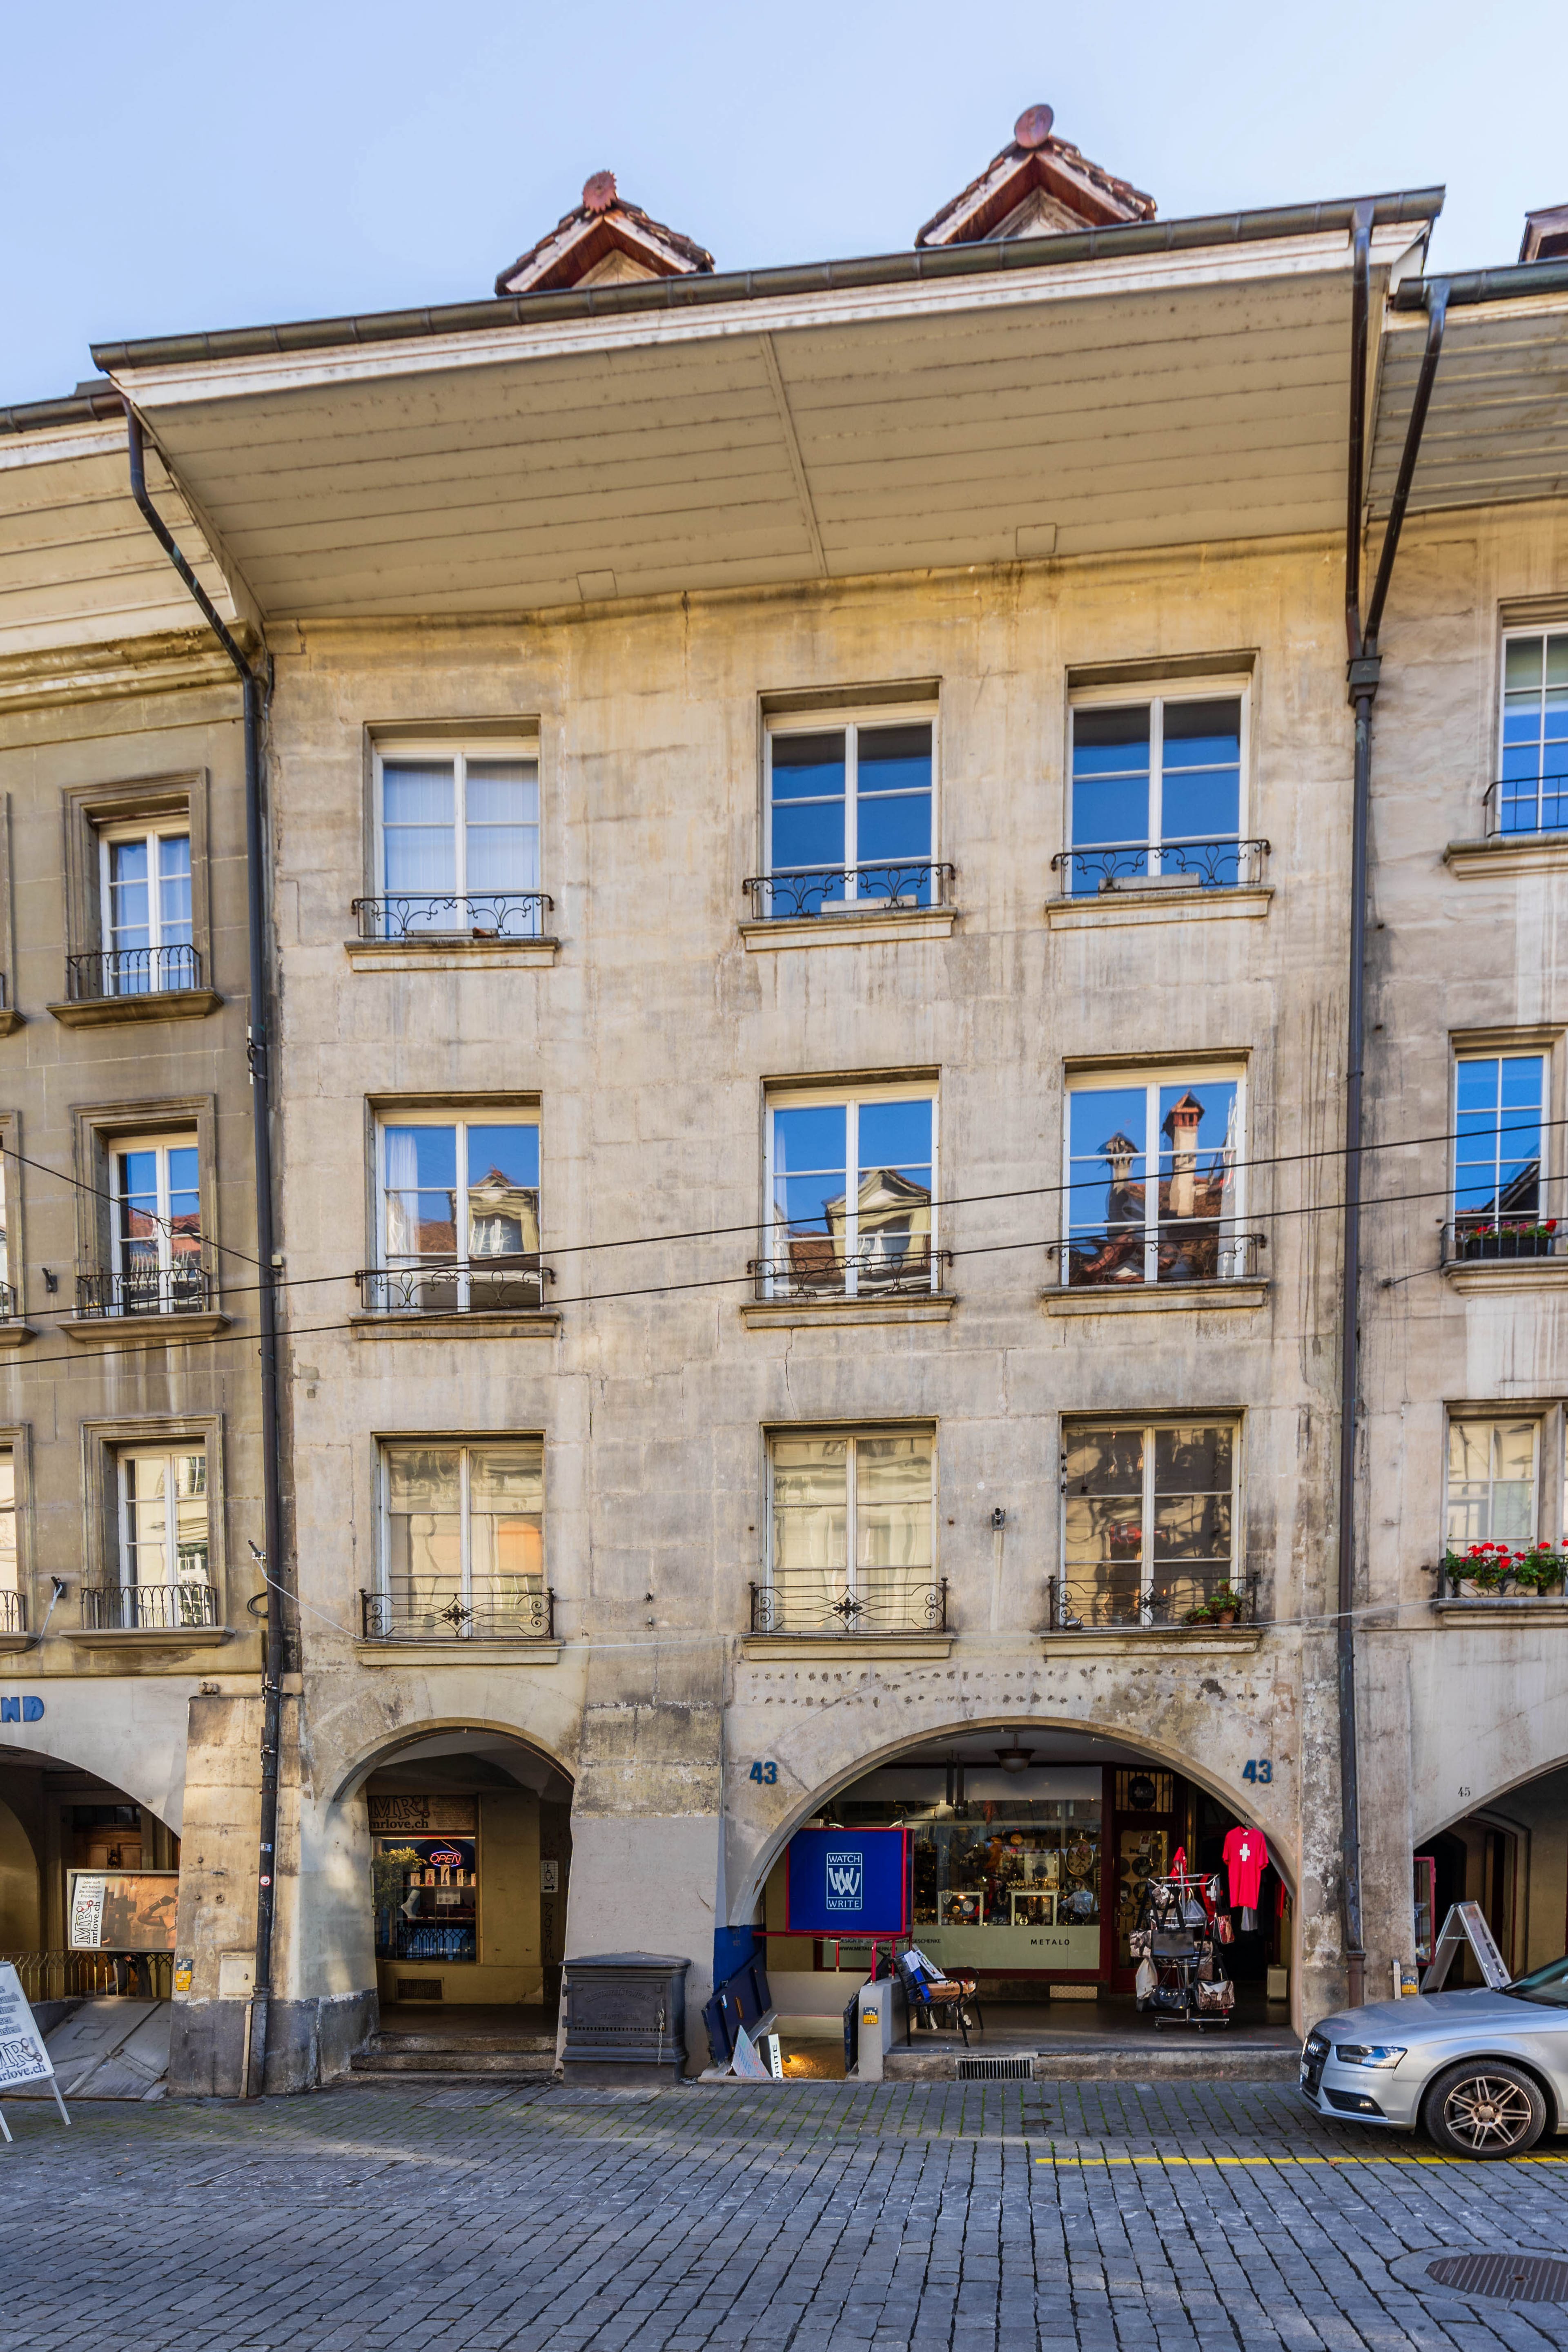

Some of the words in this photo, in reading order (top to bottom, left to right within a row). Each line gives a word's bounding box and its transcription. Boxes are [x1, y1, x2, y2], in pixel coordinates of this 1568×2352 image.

[0, 1696, 45, 1723] ND
[750, 1761, 777, 1784] 43
[1242, 1759, 1272, 1784] 43
[1458, 1787, 1470, 1797] 45
[370, 1819, 429, 1828] mrlove.ch
[430, 1855, 461, 1863] OPEN
[91, 1902, 100, 1944] mrlove.ch
